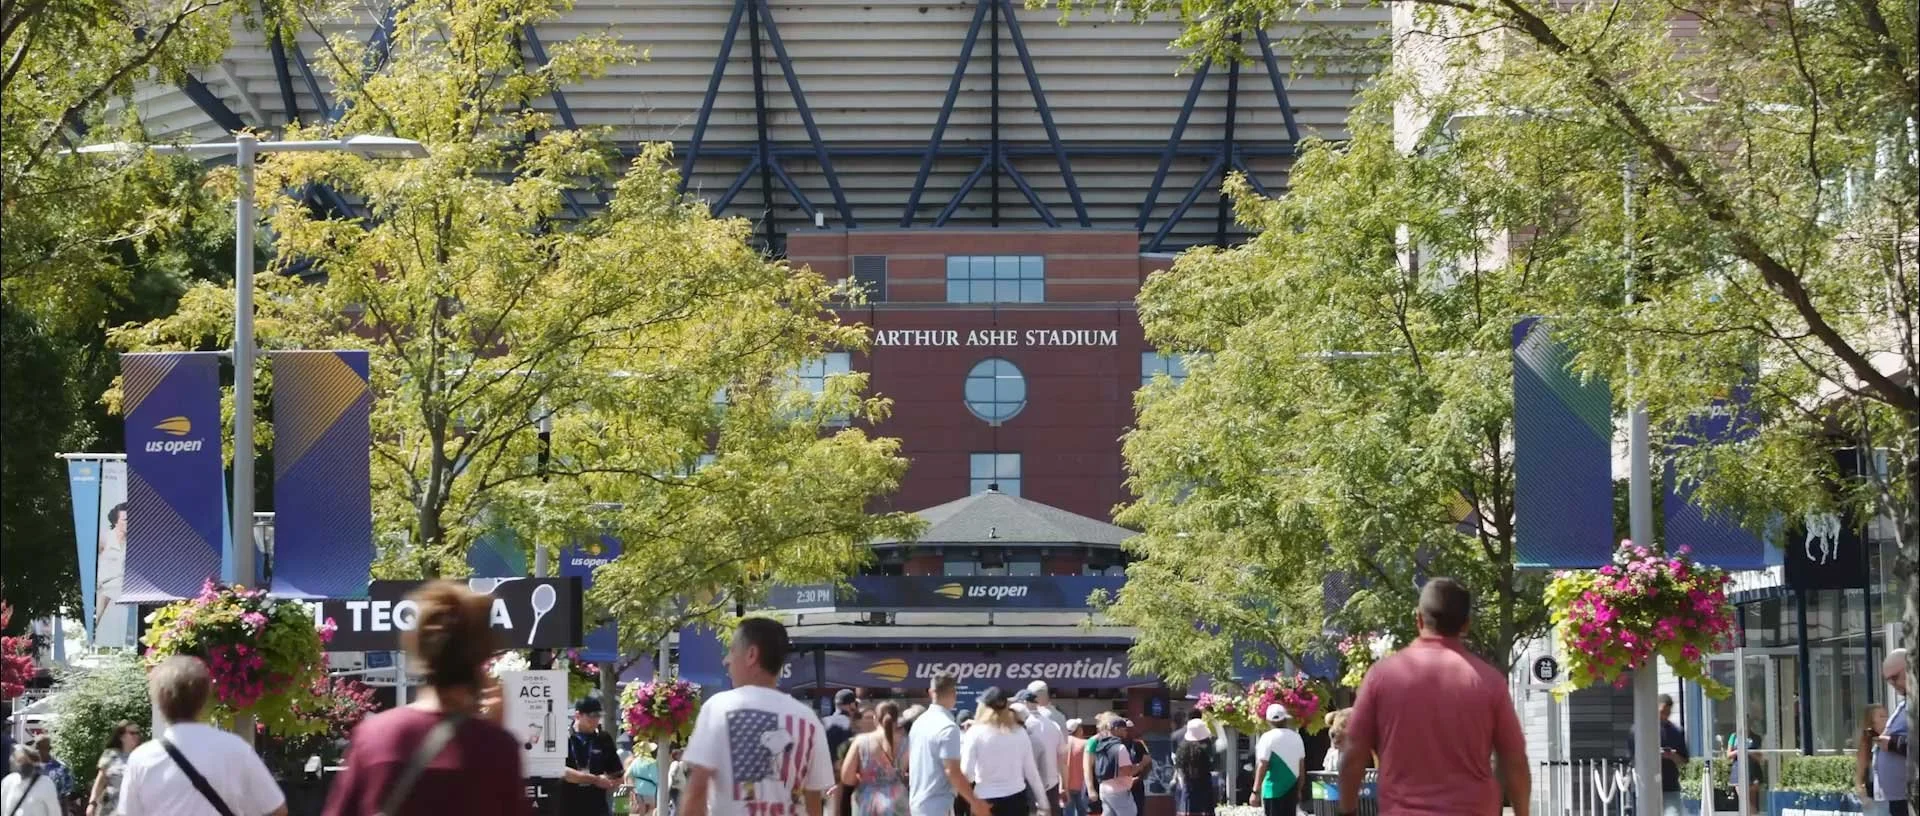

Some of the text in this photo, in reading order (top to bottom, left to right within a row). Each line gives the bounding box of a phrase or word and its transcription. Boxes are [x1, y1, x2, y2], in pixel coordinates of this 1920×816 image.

[873, 329, 1119, 346] ARTHUR ASHE STADIUM
[145, 440, 202, 455] us open
[797, 589, 830, 604] 2:30 PM
[967, 585, 1028, 601] us open
[346, 600, 513, 632] TEQA
[944, 660, 1001, 684] open
[1006, 657, 1122, 679] essentials
[519, 685, 551, 698] ACE
